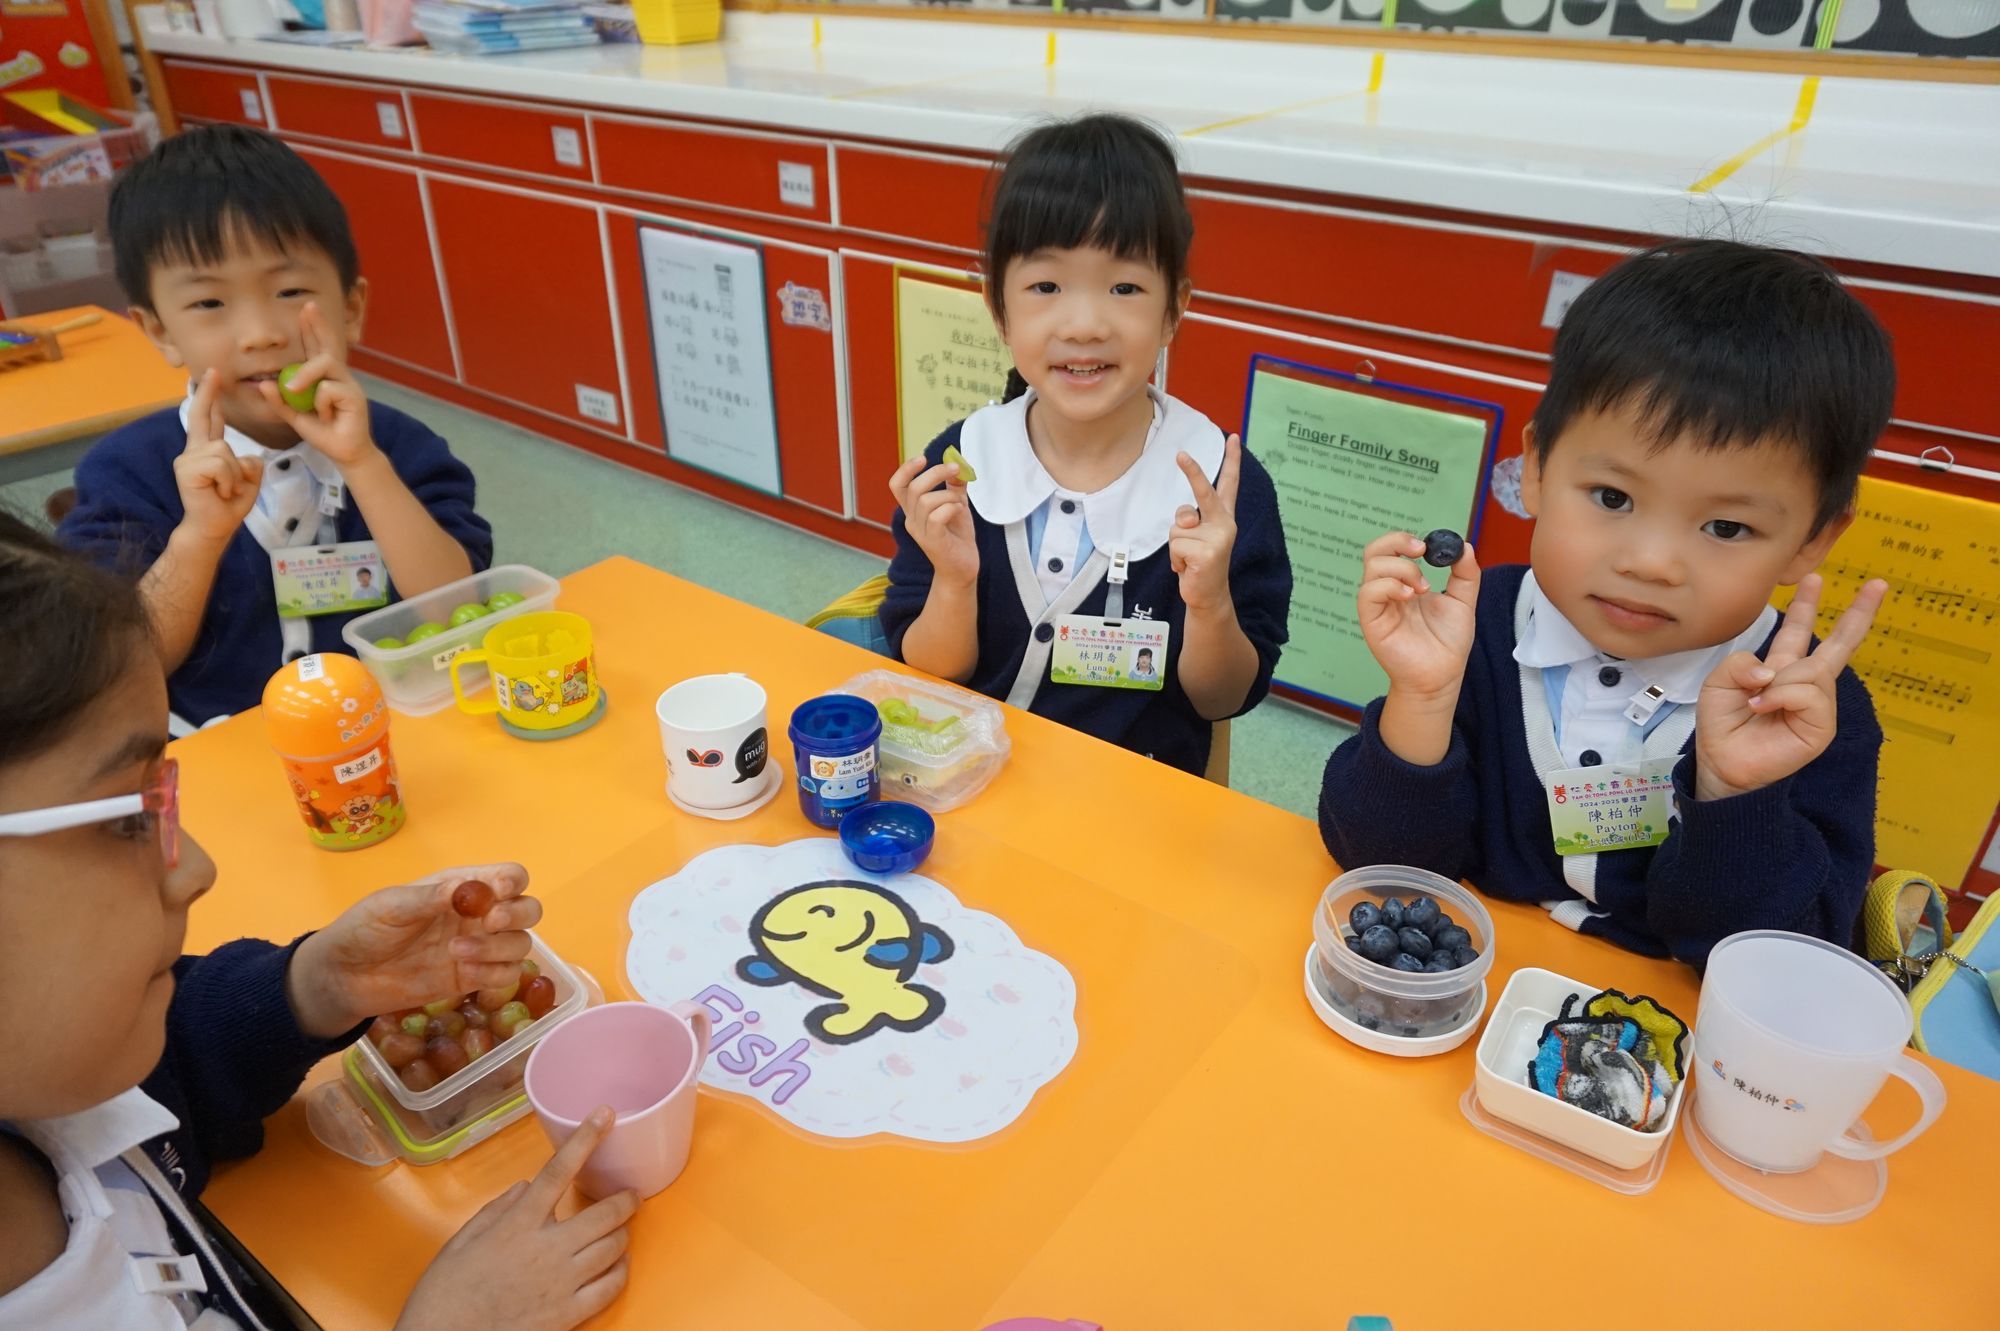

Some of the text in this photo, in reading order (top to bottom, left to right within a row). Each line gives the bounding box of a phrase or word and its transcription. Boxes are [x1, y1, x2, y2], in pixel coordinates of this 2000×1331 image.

[1288, 421, 1439, 473] Finger Family Song
[1880, 536, 1944, 561] 快樂的家
[1080, 651, 1117, 663] 林玥喬
[1087, 664, 1107, 672] Luna
[745, 741, 765, 761] mug
[853, 763, 865, 772] Yuet
[1588, 805, 1642, 822] 陳柏仲
[1596, 823, 1637, 834] Payton
[691, 984, 811, 1105] Fish
[1734, 1077, 1779, 1107] 陳柏仲
